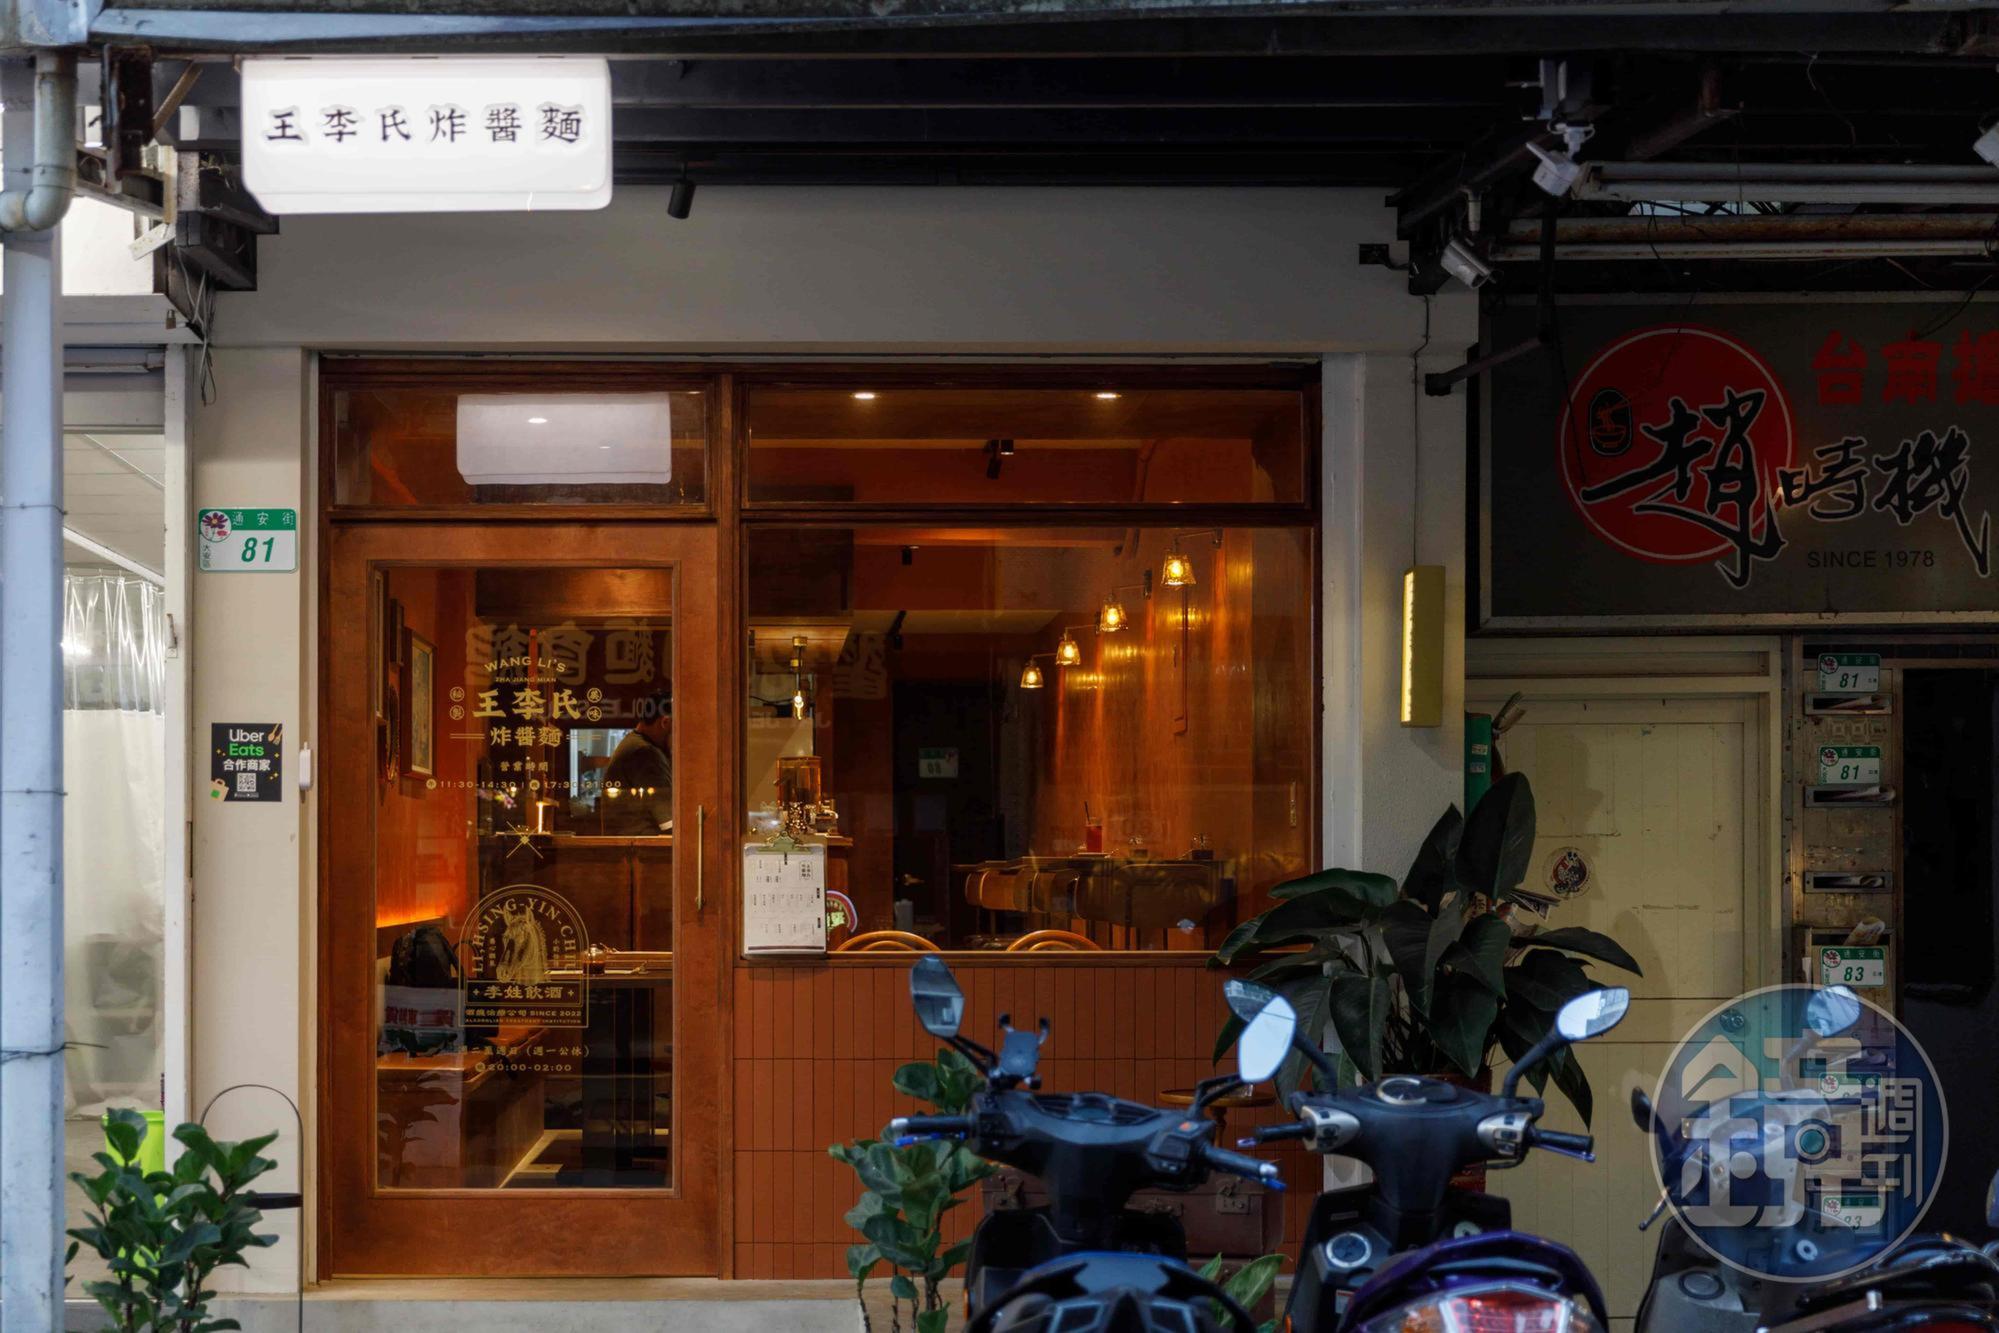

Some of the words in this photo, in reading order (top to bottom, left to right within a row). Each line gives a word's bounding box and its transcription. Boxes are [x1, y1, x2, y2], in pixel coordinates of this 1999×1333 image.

[266, 107, 583, 145] 王李氏炸醬麵
[233, 511, 294, 526] 通安街
[241, 537, 275, 562] 81
[1807, 550, 1876, 569] SINCE
[1884, 549, 1935, 568] 1978
[484, 656, 532, 673] WANG
[537, 656, 567, 673] LI'S
[1839, 673, 1859, 688] 81
[472, 688, 581, 720] 王李氏
[229, 729, 264, 742] Uber
[490, 725, 561, 748] 炸醬麵
[229, 743, 264, 756] Eats
[223, 759, 271, 771] 合作商家
[1841, 765, 1860, 780] 81
[1844, 966, 1864, 982] 83
[484, 985, 563, 1000] 李姓飲酒
